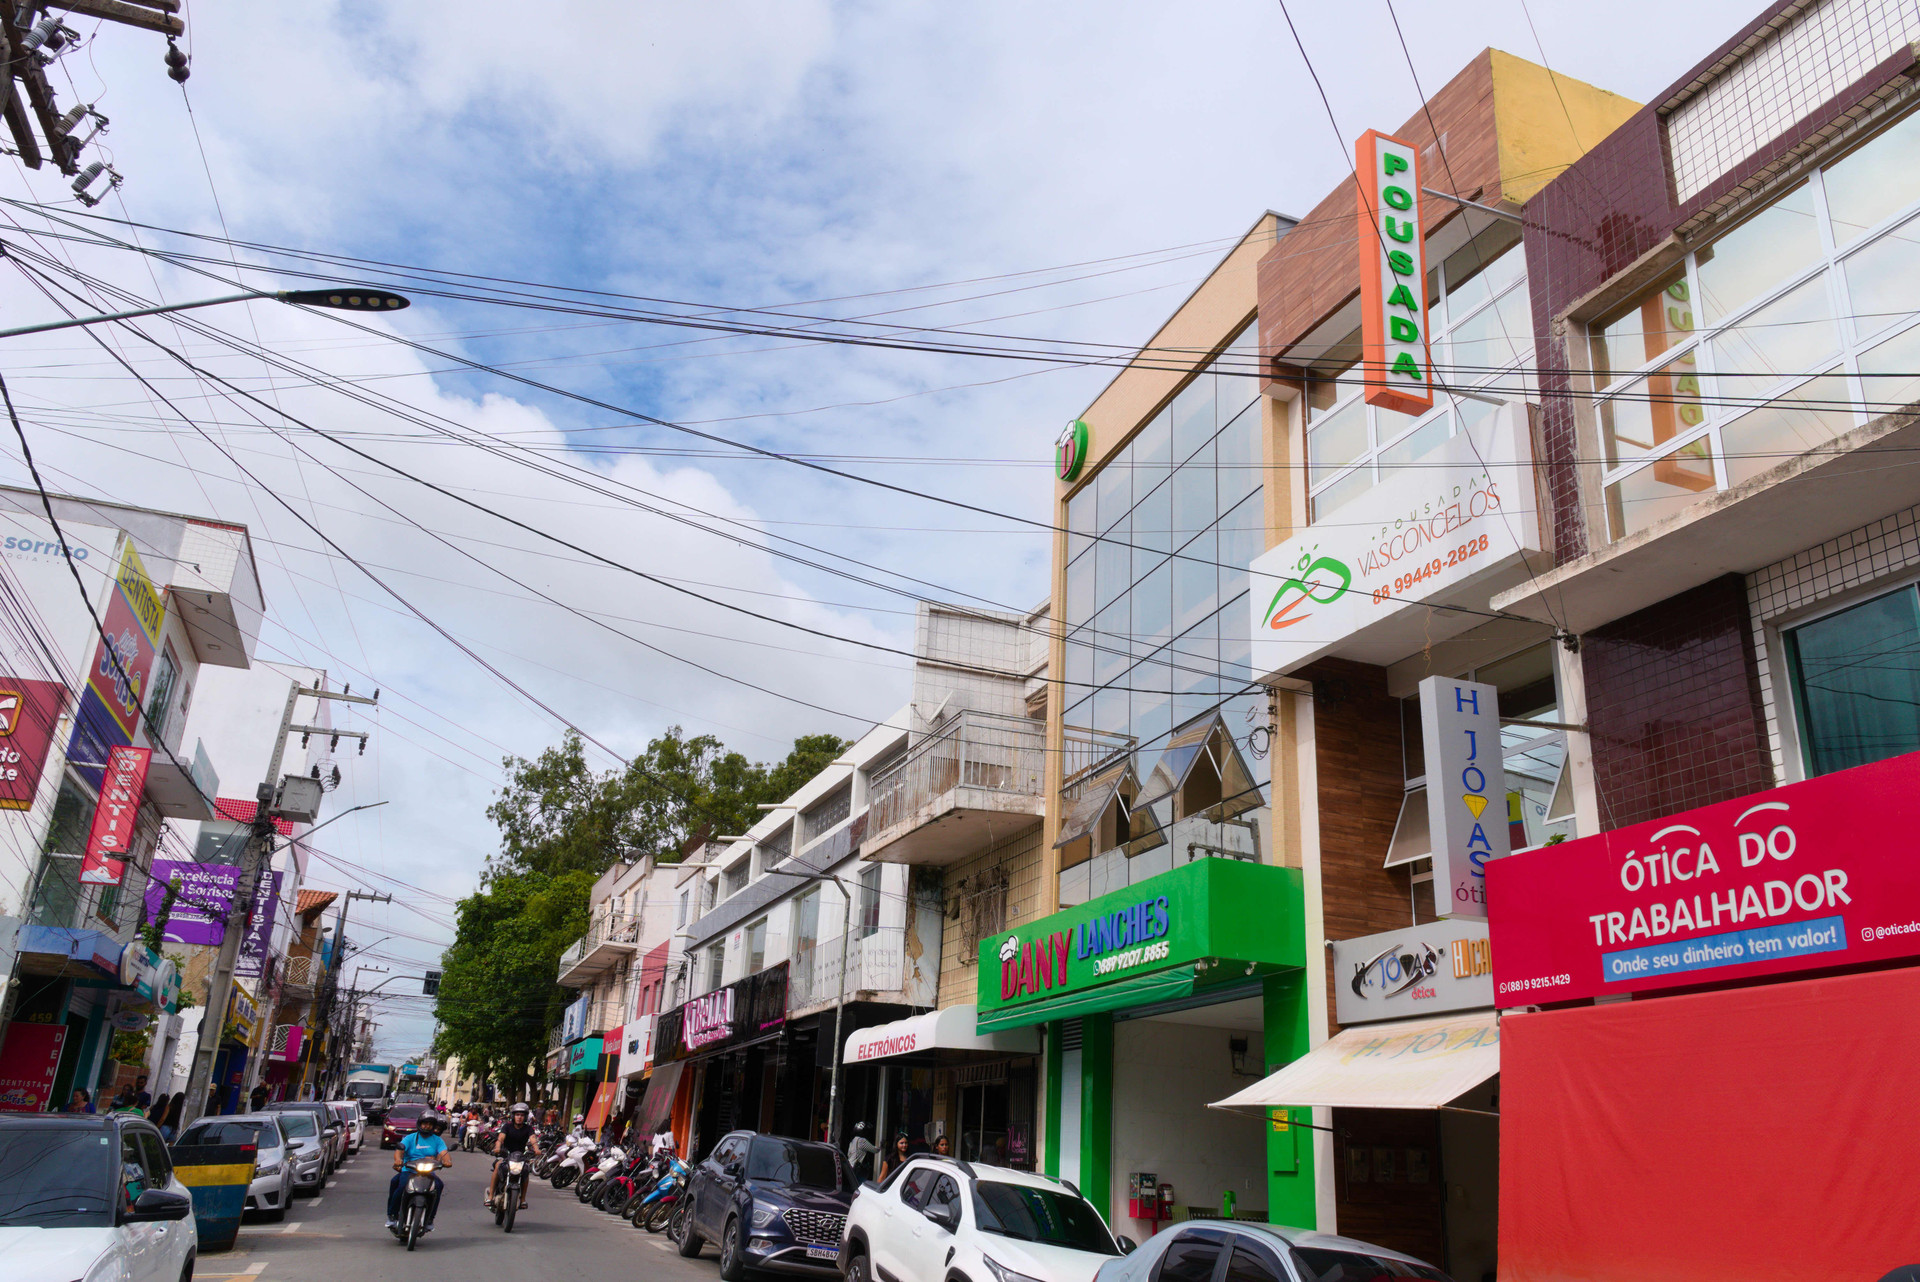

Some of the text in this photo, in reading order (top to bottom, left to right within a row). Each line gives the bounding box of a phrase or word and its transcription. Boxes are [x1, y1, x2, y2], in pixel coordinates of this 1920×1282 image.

[1383, 152, 1422, 381] POUSADA
[1357, 483, 1500, 577] VASCONCELOS
[1381, 477, 1477, 539] POUSADA
[4, 537, 89, 560] sorriso
[1373, 534, 1489, 605] 88 99449-2828
[122, 554, 160, 640] DENTISTA
[1454, 686, 1480, 715] H
[98, 759, 137, 880] DENTISTA
[169, 868, 235, 885] Excelência
[1620, 824, 1797, 892] ÓTICA DO
[187, 884, 234, 898] Sorrisos
[248, 871, 273, 940] DENTISTA
[1455, 882, 1487, 904] óti
[1589, 868, 1852, 946] TRABALHADOR
[1001, 896, 1169, 1000] DANY LANCHES
[1612, 926, 1837, 975] Onde seu dinheiro tem valor!
[1412, 987, 1436, 999] ótica
[1507, 974, 1571, 993] (88) 9 9215.1429
[29, 1012, 53, 1022] 459
[857, 1033, 916, 1060] ELETRÔNICOS
